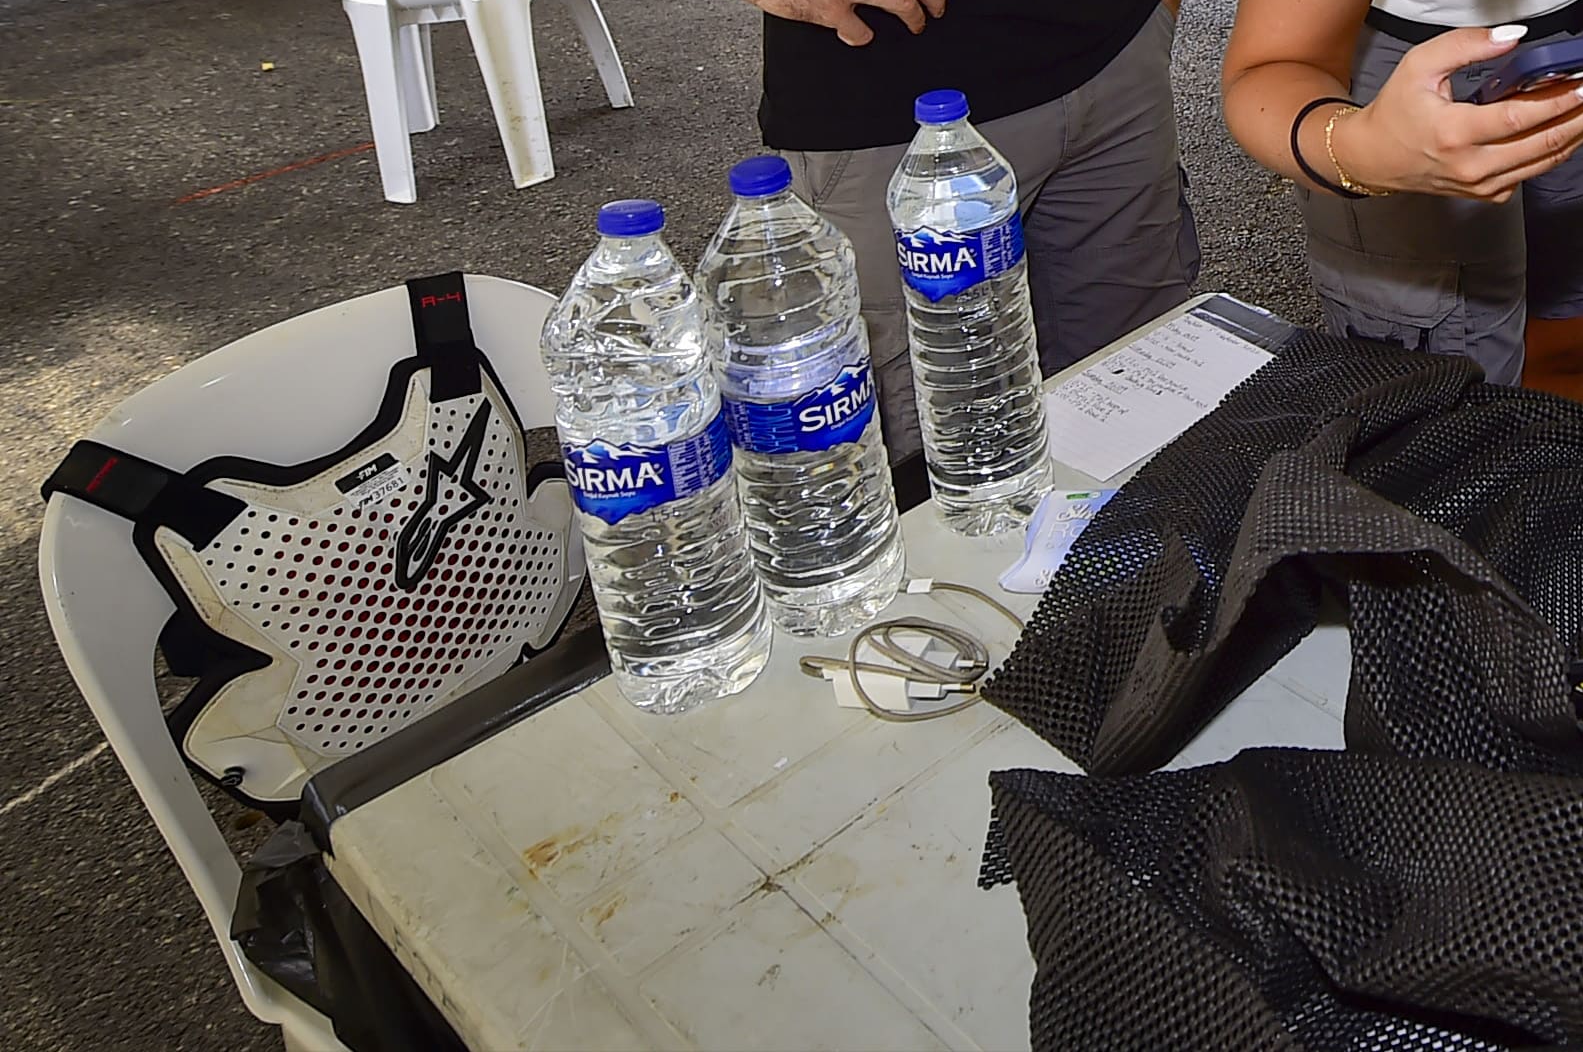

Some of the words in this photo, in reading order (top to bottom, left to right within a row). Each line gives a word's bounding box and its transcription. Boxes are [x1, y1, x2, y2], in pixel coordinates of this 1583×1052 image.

[896, 242, 977, 273] SIRMA
[421, 291, 462, 308] A-4
[799, 370, 875, 432] SIRMA
[359, 463, 377, 480] FIM
[564, 458, 664, 492] SIRMA
[373, 477, 404, 499] 37681
